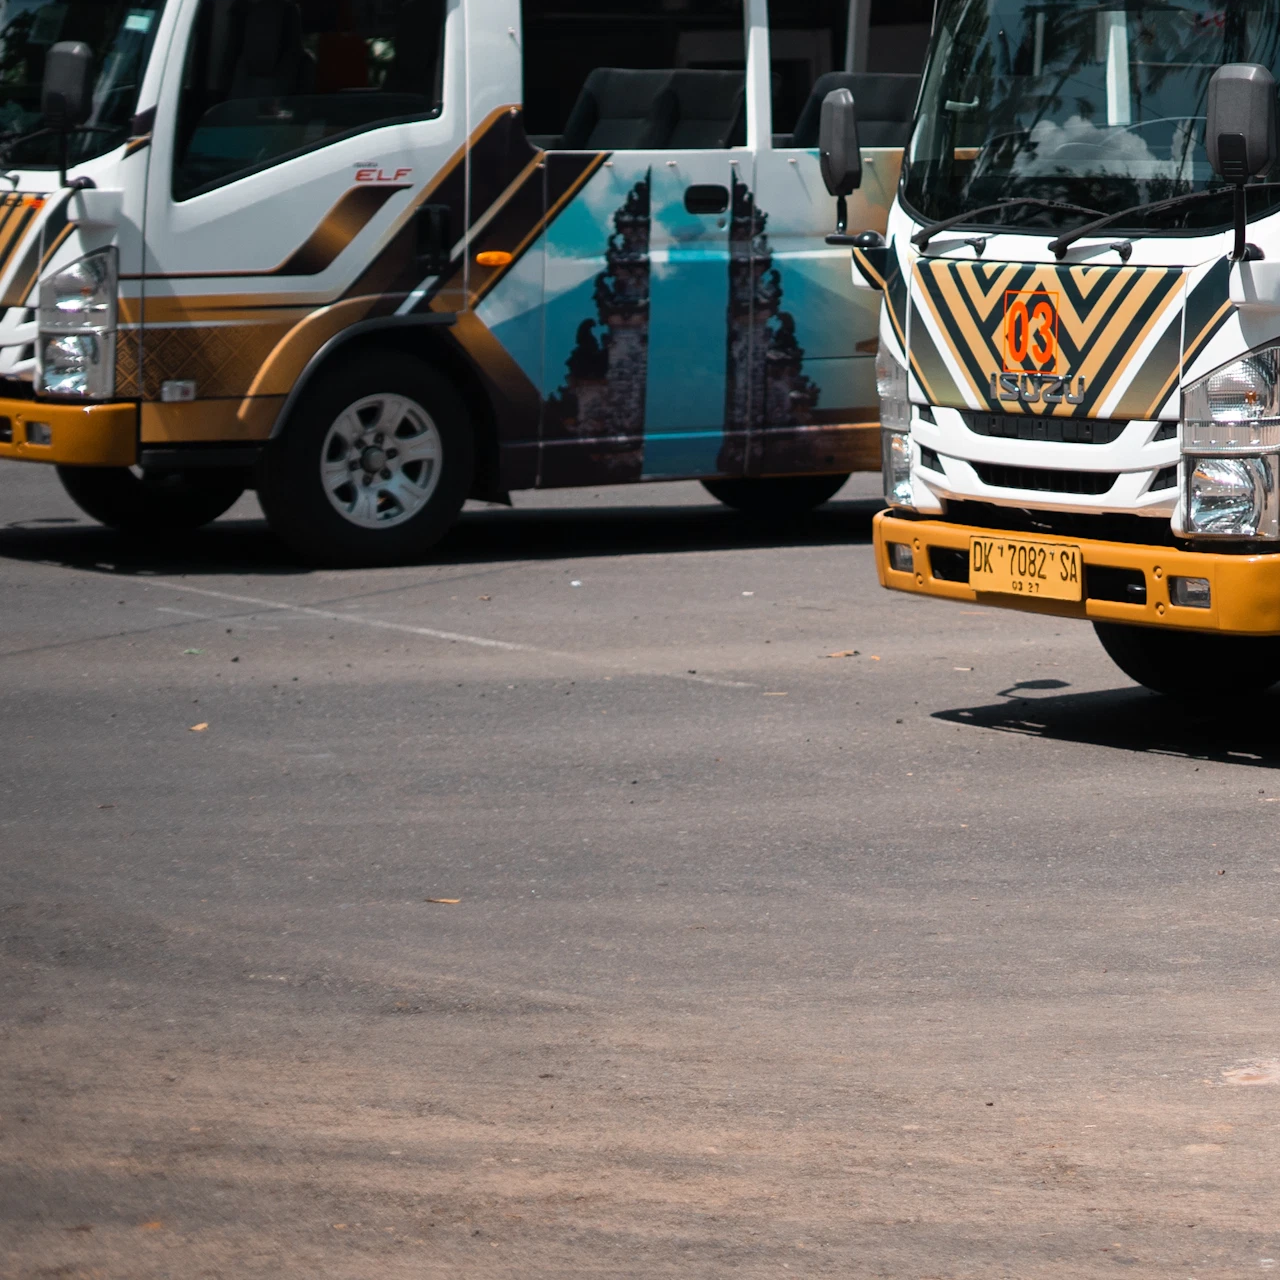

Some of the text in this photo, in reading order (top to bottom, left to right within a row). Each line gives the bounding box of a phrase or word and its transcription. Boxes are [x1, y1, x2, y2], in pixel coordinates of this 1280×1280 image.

[355, 169, 413, 181] ELF
[1008, 301, 1053, 363] 03
[990, 372, 1085, 404] ISUZU
[974, 541, 1078, 583] DK 7082 SA
[1012, 581, 1039, 593] 03 27
